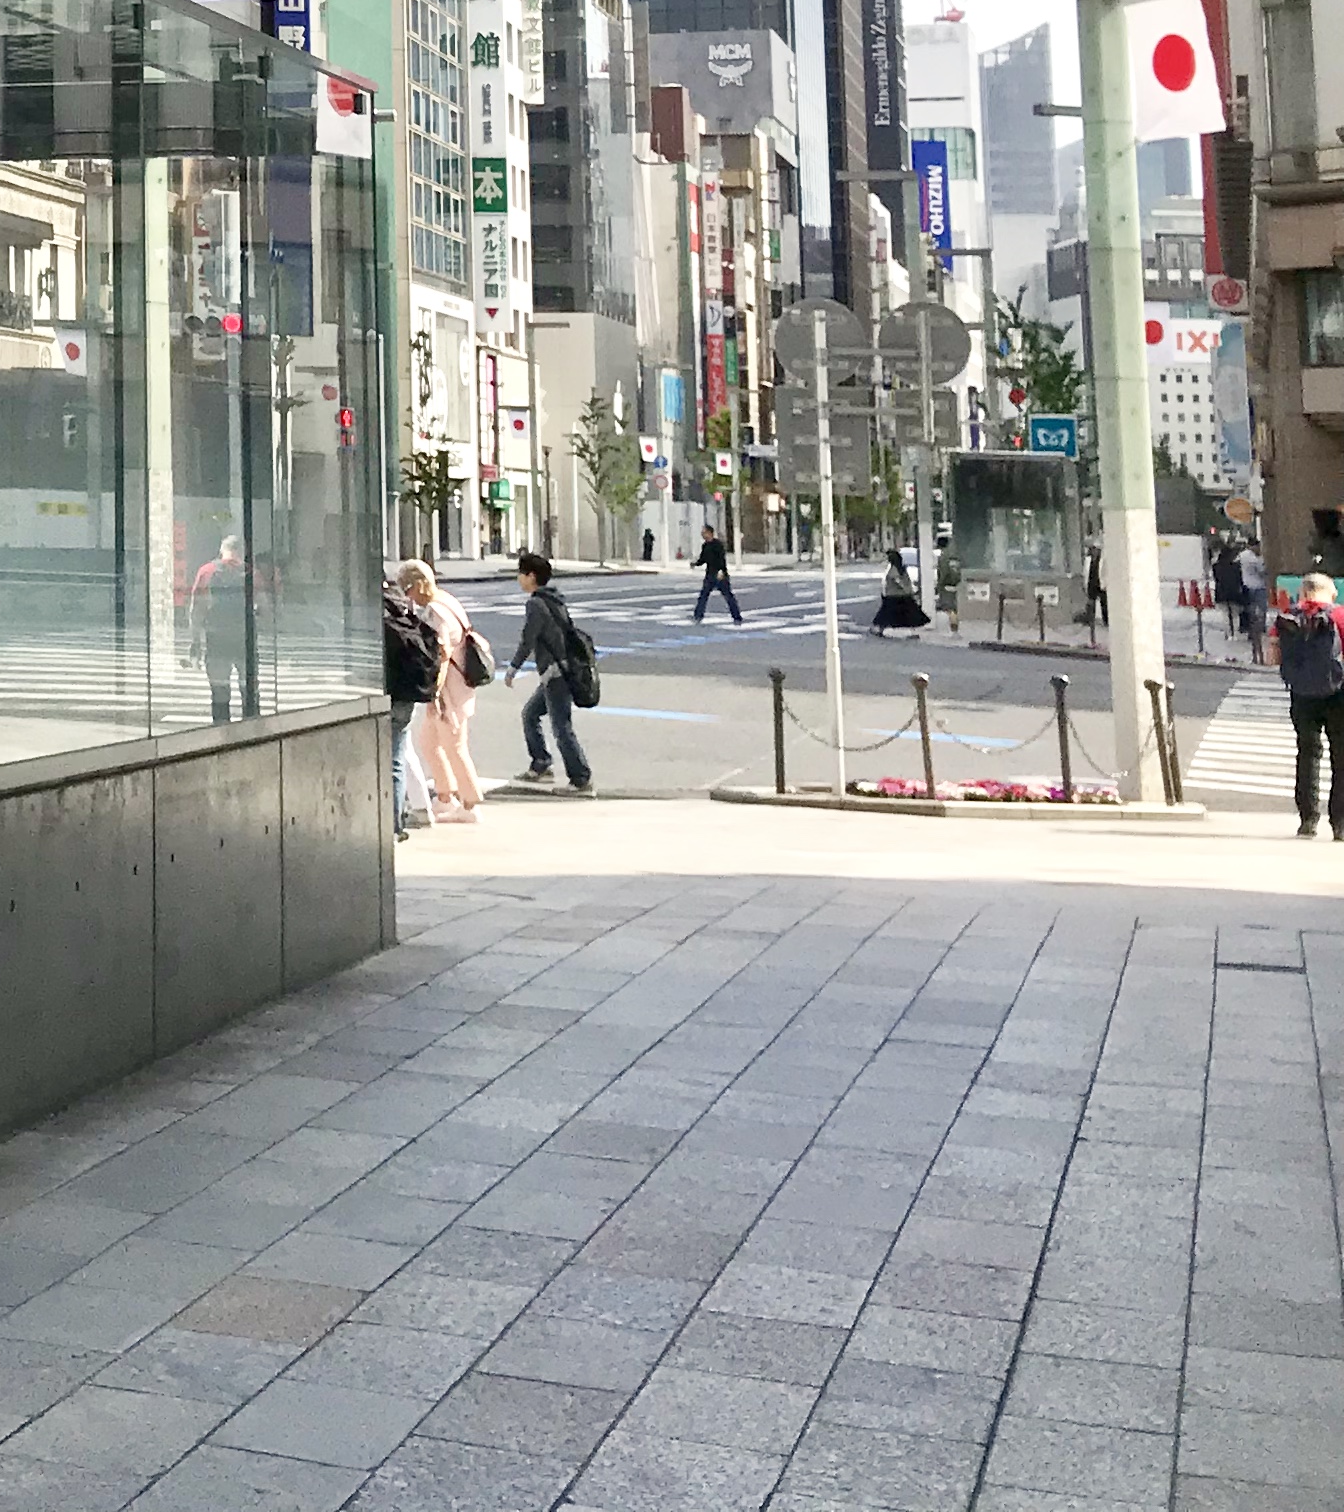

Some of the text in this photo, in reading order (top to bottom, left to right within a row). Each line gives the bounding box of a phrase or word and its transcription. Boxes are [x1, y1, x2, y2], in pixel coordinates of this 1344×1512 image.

[708, 43, 752, 61] MCM
[474, 166, 503, 205] 本
[926, 164, 944, 236] MIZUHO
